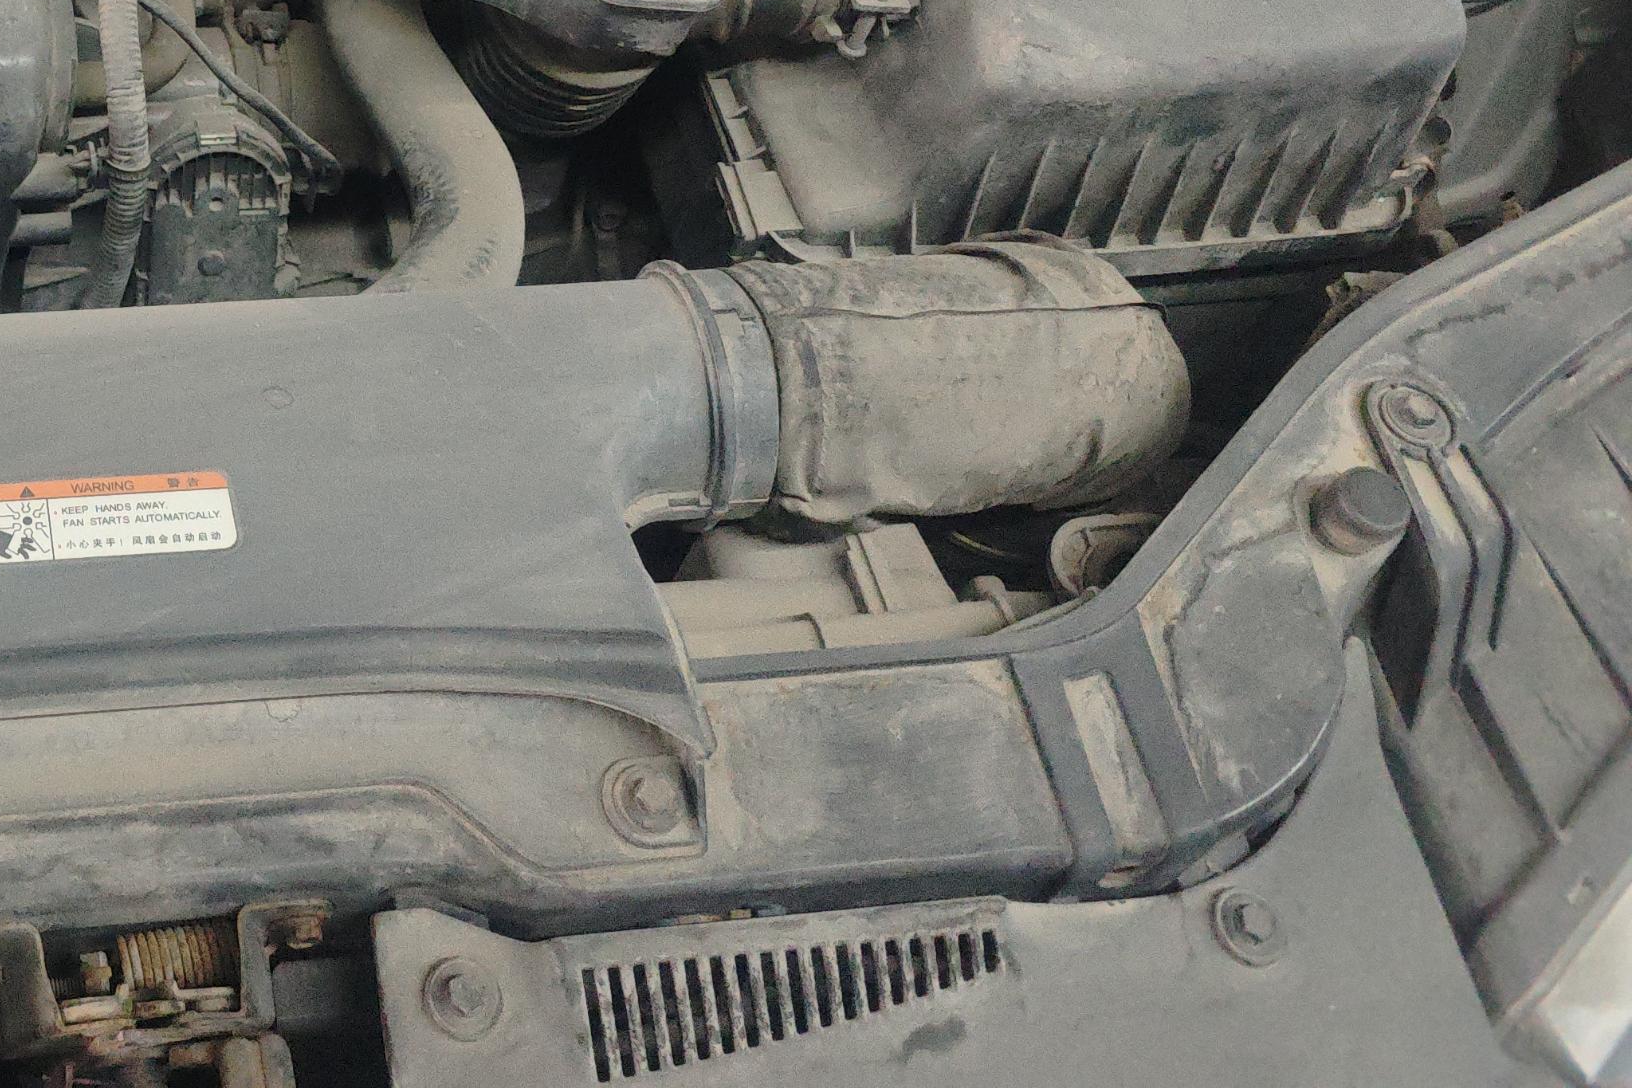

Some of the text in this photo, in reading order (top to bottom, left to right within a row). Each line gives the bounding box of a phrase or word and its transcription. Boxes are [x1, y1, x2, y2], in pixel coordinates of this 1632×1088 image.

[70, 479, 135, 494] WARNING
[61, 504, 89, 515] KEEP
[95, 502, 132, 513] HANDS
[62, 518, 84, 528] FAN
[90, 515, 130, 526] STARTS
